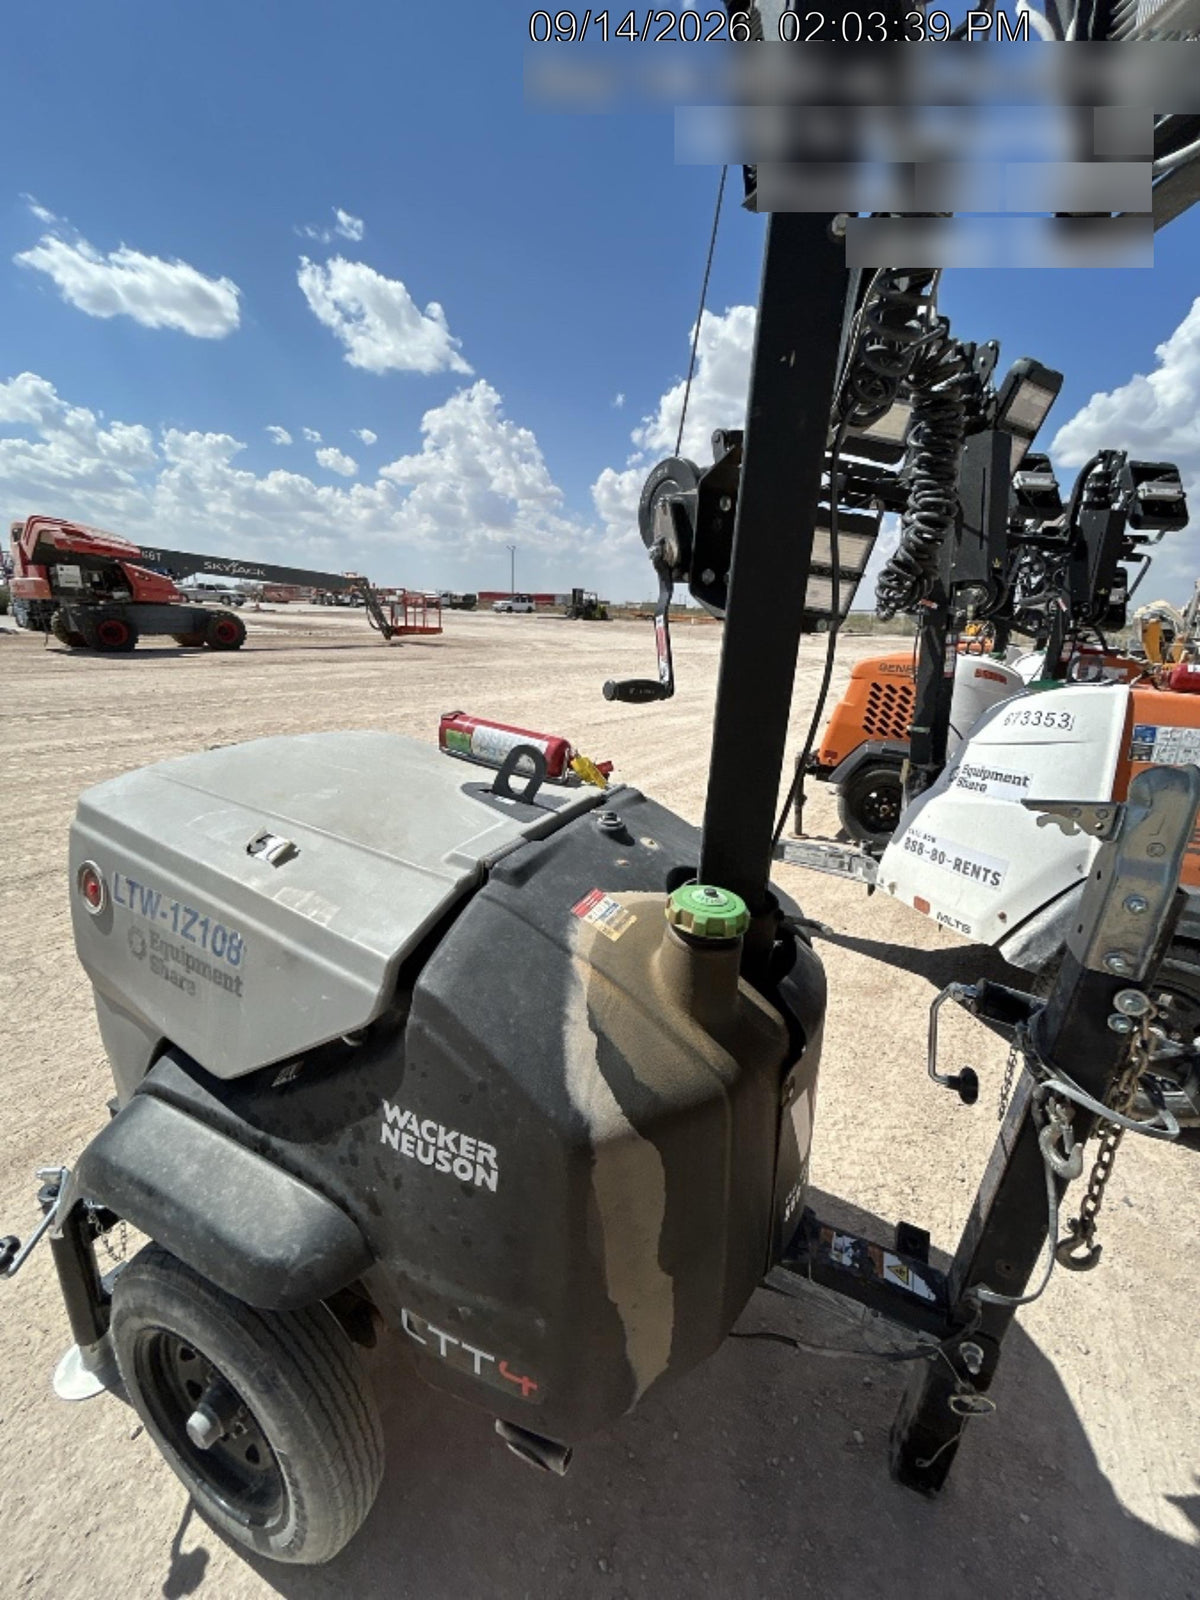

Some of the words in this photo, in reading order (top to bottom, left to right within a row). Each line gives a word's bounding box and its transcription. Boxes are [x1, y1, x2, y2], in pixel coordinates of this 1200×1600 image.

[203, 561, 266, 577] SKYJACK
[961, 764, 1030, 787] Equipment
[904, 837, 1002, 886] 888-80-RENTS
[113, 872, 244, 966] LTW-1Z108
[149, 928, 243, 998] Equipment
[150, 955, 196, 996] Share
[380, 1122, 499, 1193] NEUSON
[382, 1098, 498, 1169] WACKER
